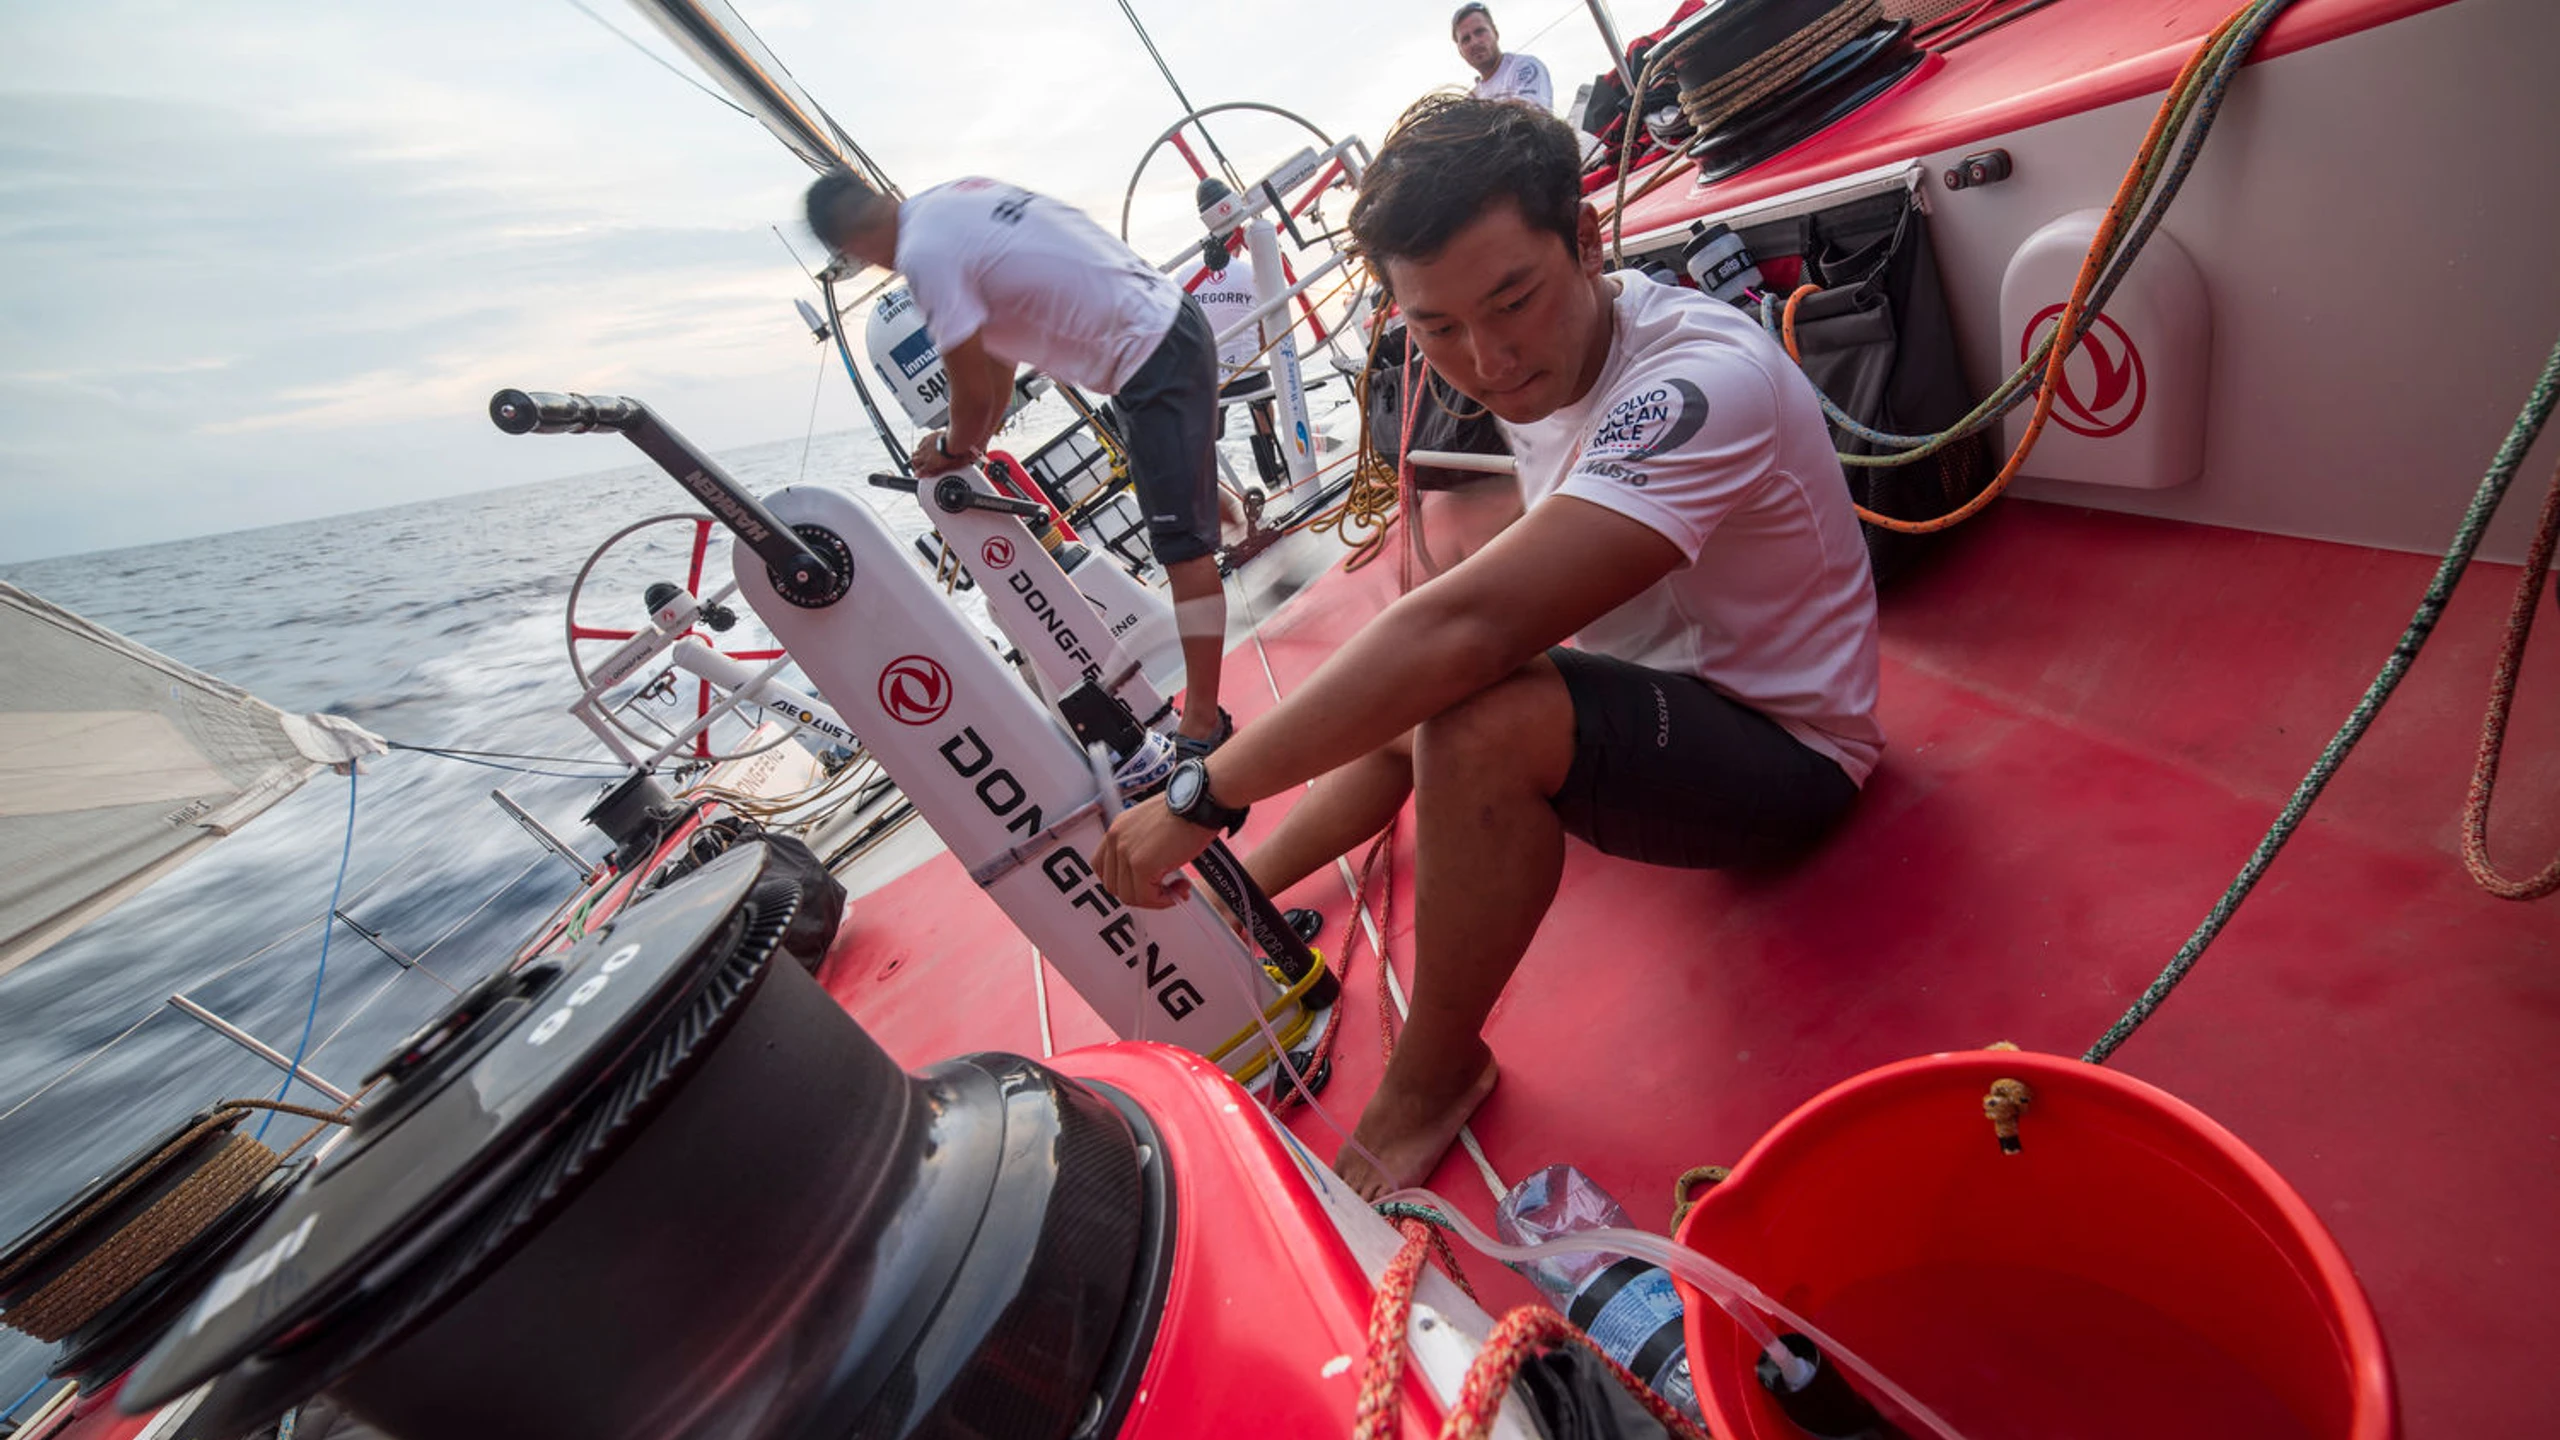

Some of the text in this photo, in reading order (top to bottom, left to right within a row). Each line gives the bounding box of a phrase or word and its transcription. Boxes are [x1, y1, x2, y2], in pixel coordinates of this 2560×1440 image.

[902, 344, 940, 376] inmar
[685, 470, 770, 542] HARKEN
[1650, 682, 1669, 747] MUSTO
[736, 748, 785, 794] ONGFENG
[1201, 854, 1238, 899] KATADYN
